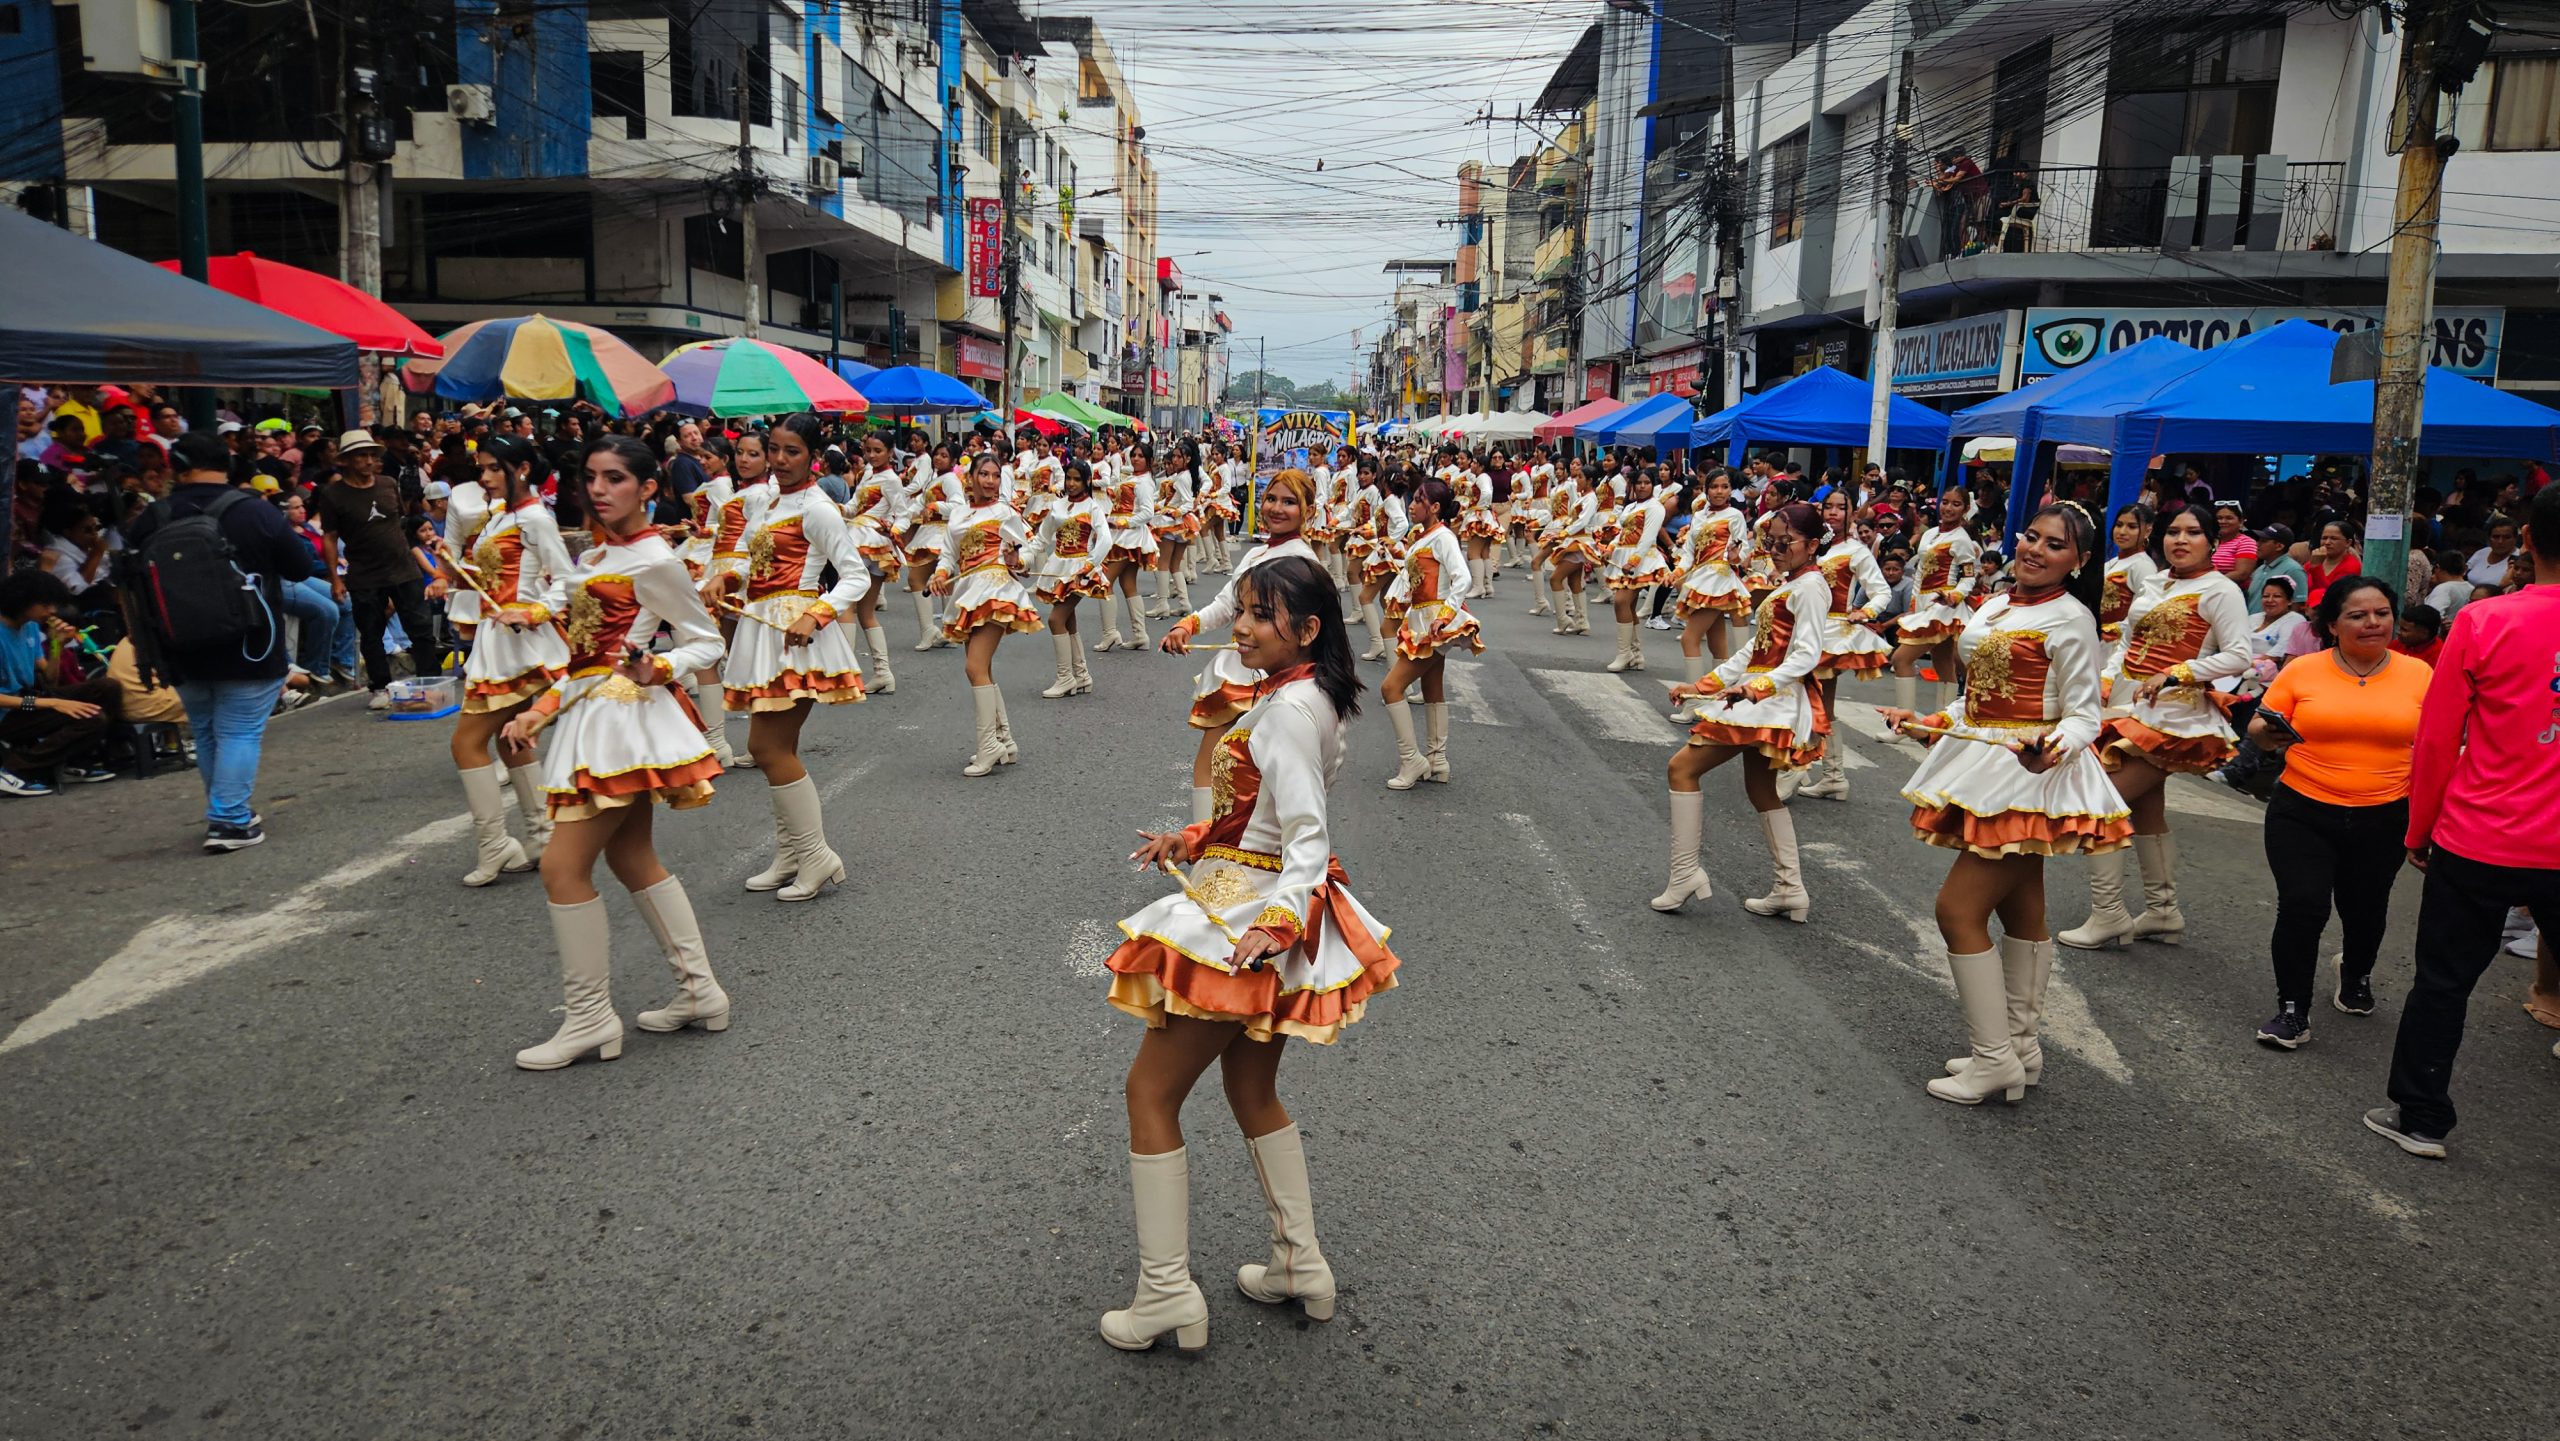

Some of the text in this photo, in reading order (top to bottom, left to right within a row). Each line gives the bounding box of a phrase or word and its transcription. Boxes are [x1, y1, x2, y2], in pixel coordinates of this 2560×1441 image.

[971, 200, 983, 295] farmacias
[986, 226, 997, 290] suiza
[1934, 322, 2002, 372] MEGALENS
[1284, 412, 1322, 431] VIVA
